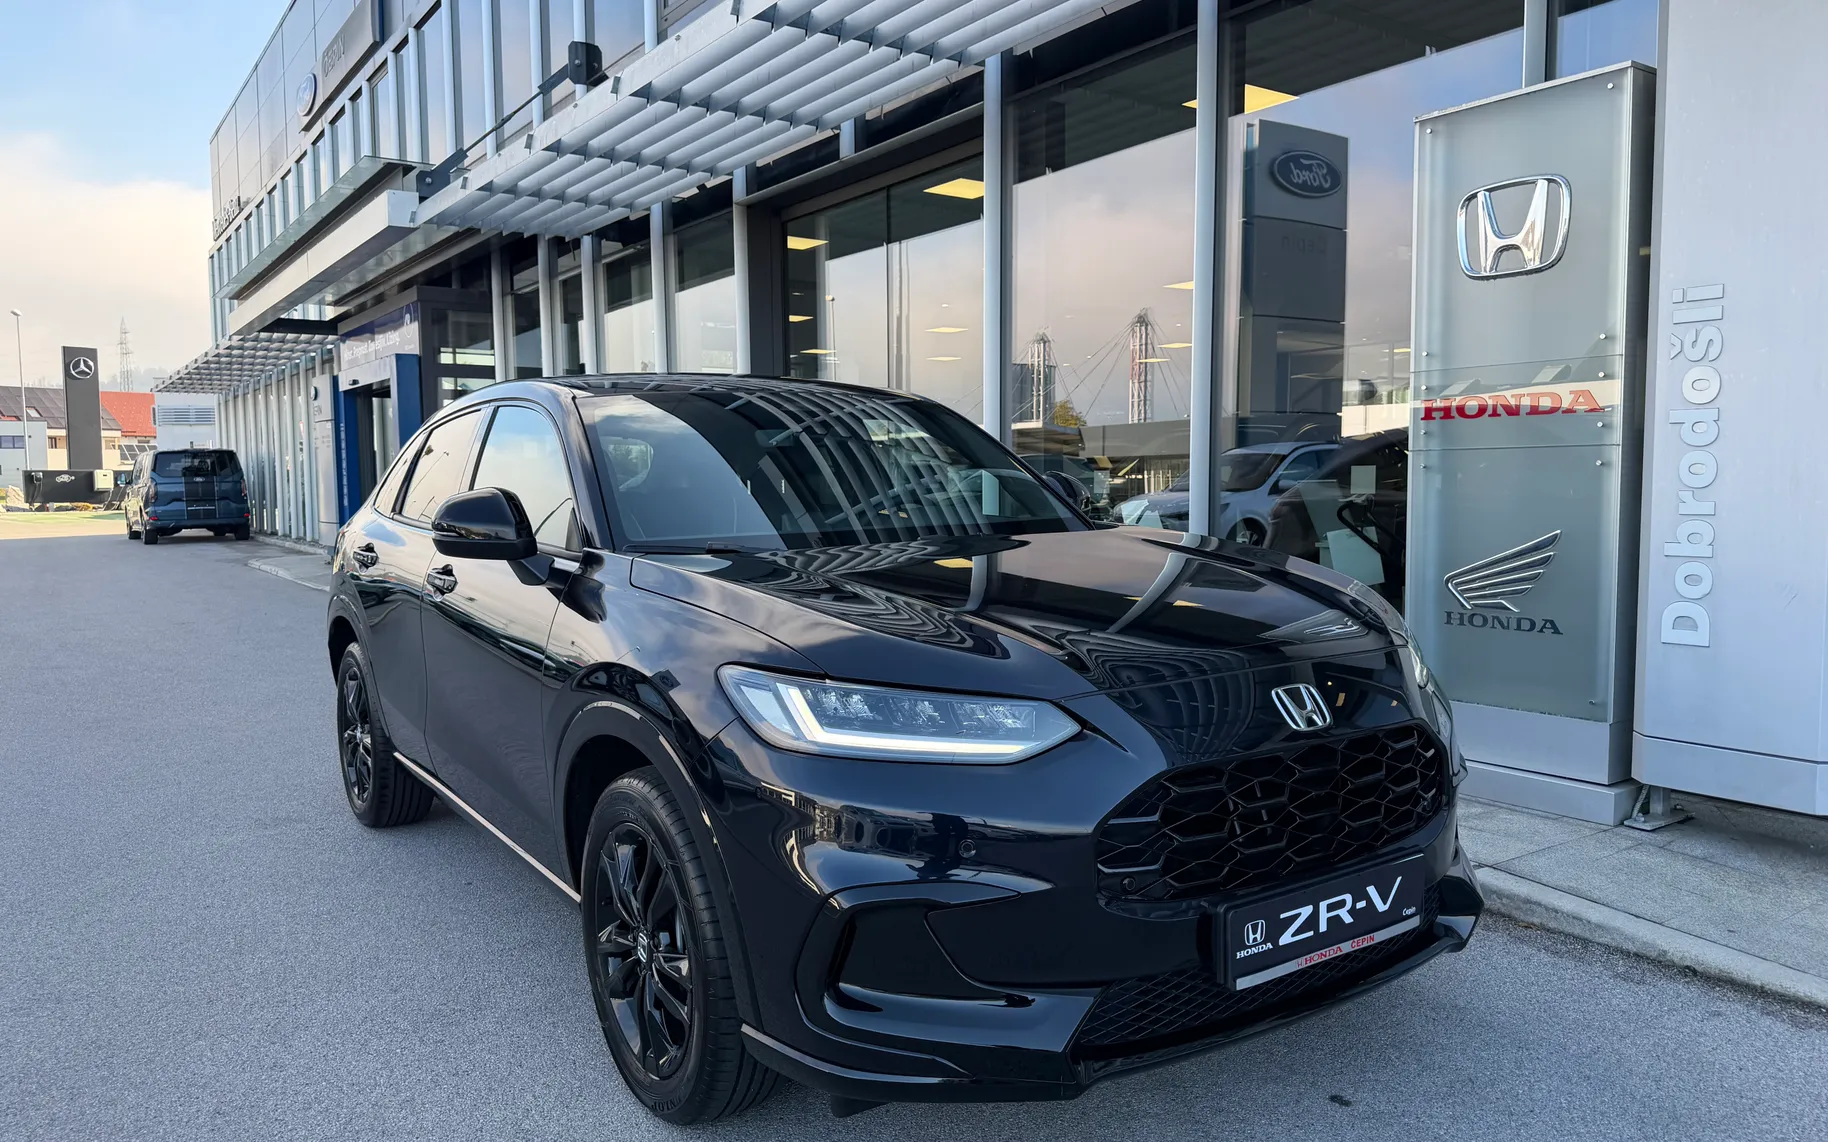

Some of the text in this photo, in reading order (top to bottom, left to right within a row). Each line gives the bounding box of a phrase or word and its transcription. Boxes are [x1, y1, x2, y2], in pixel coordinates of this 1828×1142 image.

[1420, 389, 1606, 421] HONDA
[1661, 283, 1724, 648] Dobrodošli
[1443, 610, 1564, 635] HONDA
[1279, 876, 1402, 946] ZR-V
[1236, 942, 1273, 959] HONDA
[1304, 946, 1342, 965] HONDA
